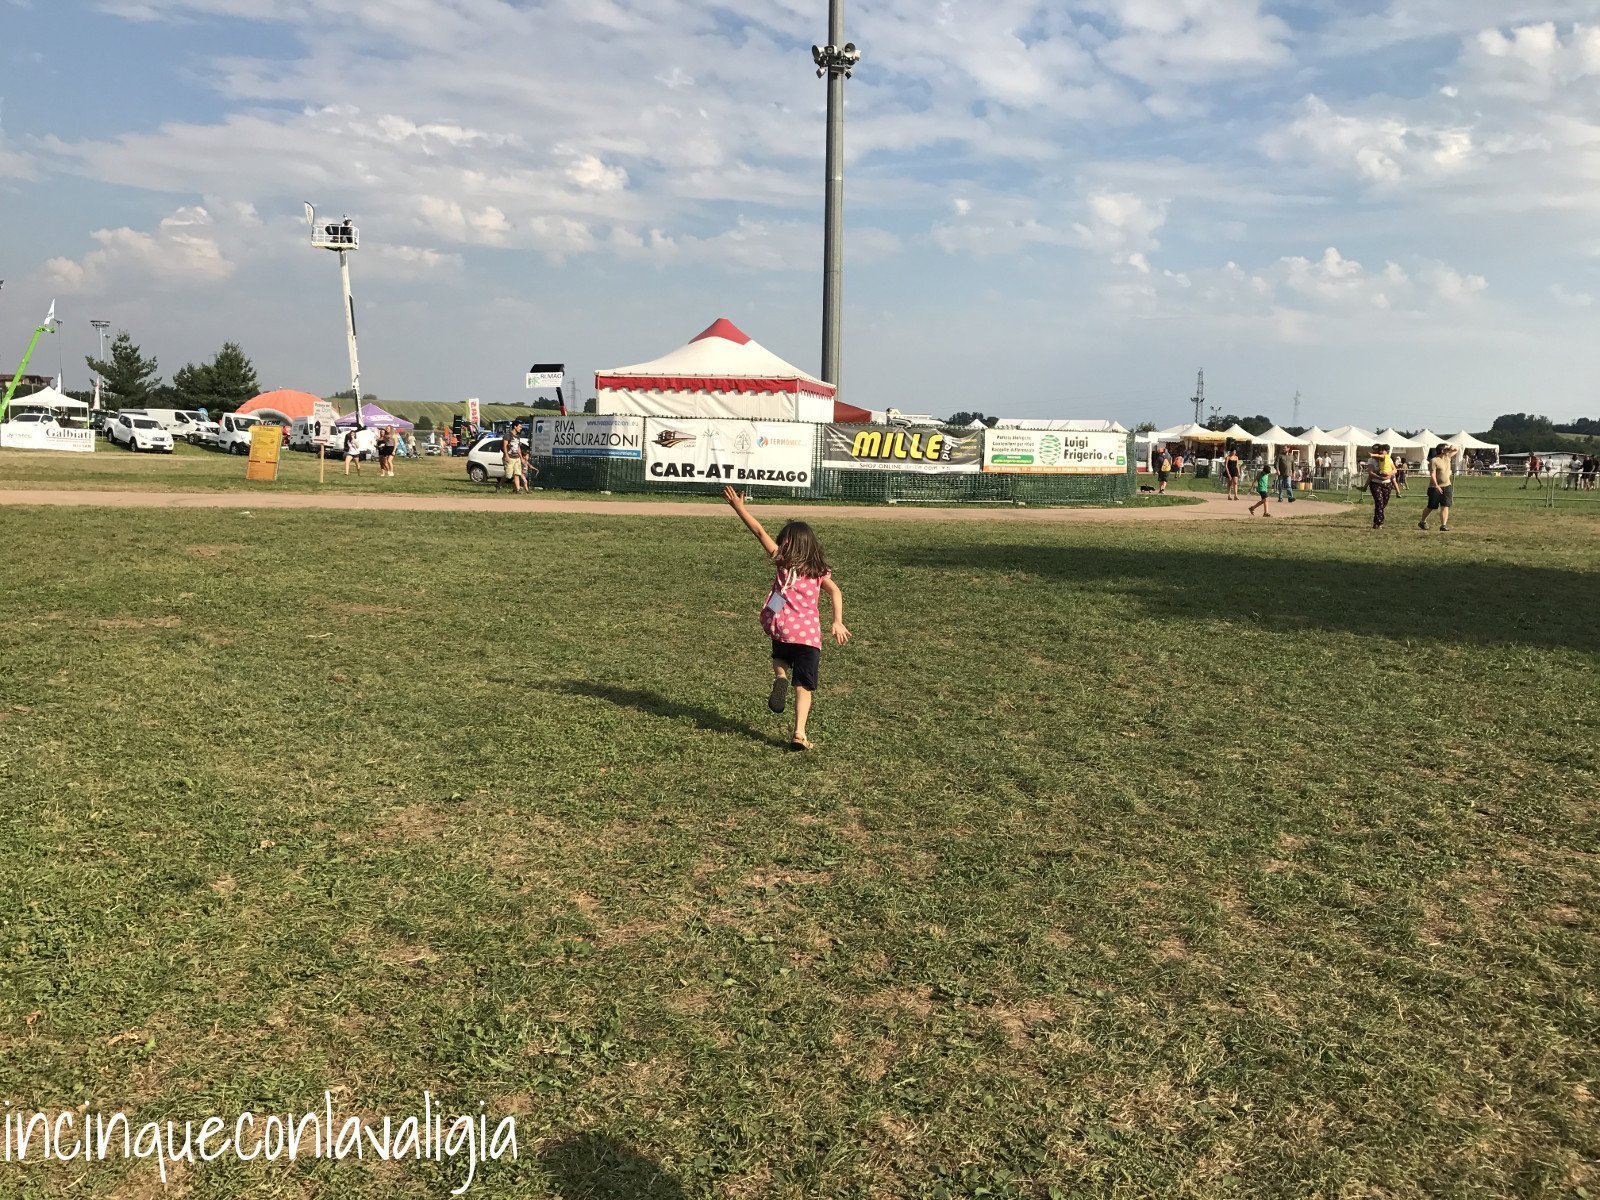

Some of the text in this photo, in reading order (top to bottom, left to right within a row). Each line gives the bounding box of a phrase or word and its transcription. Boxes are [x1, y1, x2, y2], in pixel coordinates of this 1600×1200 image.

[45, 428, 92, 439] Galbiati
[554, 420, 576, 433] RIVA
[553, 432, 639, 448] ASSICURAZIONI
[851, 430, 944, 461] MILLE
[1064, 436, 1089, 450] Luigi
[1063, 449, 1103, 462] Frigerio
[650, 462, 809, 483] CAR-AT BARZAGO
